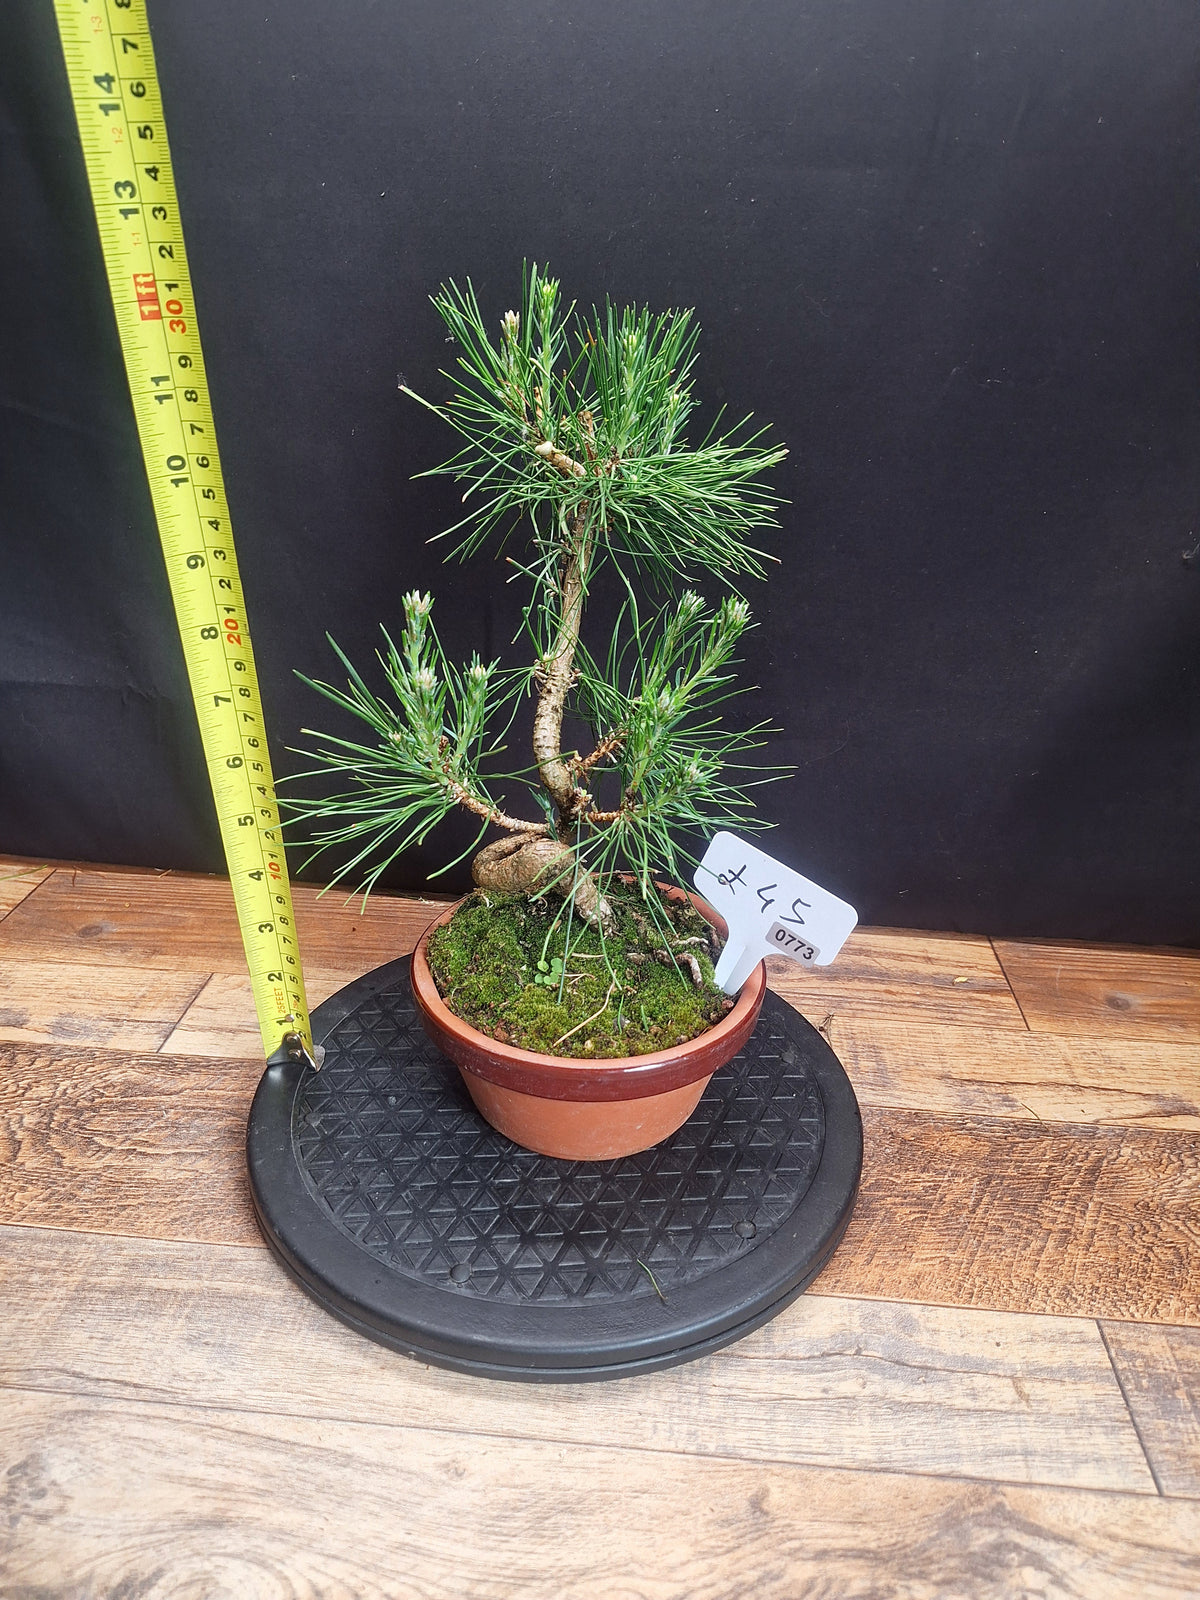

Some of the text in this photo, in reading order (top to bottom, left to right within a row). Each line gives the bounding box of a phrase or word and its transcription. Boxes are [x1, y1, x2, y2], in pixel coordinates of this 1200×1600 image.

[121, 38, 139, 54] 7
[93, 73, 120, 116] 14
[130, 81, 146, 98] 6
[137, 125, 154, 140] 5
[145, 165, 160, 181] 4
[114, 180, 140, 220] 13
[152, 206, 167, 220] 3
[159, 245, 174, 259] 2
[165, 283, 179, 292] 1
[166, 299, 187, 334] 30
[178, 355, 192, 368] 9
[150, 375, 173, 405] 11
[184, 390, 198, 403] 8
[190, 423, 204, 435] 7
[196, 456, 210, 468] 6
[166, 455, 189, 488] 10
[202, 488, 216, 501] 5
[208, 519, 221, 531] 4
[213, 549, 226, 561] 3
[186, 554, 206, 570] 9
[218, 579, 232, 590] 2
[200, 626, 219, 640] 8
[224, 618, 242, 646] 20
[234, 661, 246, 672] 9
[239, 688, 251, 698] 8
[214, 695, 232, 707] 7
[243, 713, 256, 723] 7
[248, 738, 260, 748] 6
[226, 756, 244, 769] 6
[253, 762, 264, 772] 5
[257, 786, 267, 796] 4
[261, 809, 271, 819] 3
[238, 815, 255, 827] 5
[264, 831, 276, 841] 2
[248, 870, 264, 881] 4
[268, 862, 282, 880] 10
[276, 896, 286, 905] 9
[279, 916, 289, 926] 8
[258, 923, 274, 933] 3
[283, 936, 292, 945] 7
[775, 929, 814, 960] 0773
[286, 956, 295, 965] 6
[267, 972, 283, 982] 2
[289, 975, 299, 984] 5
[292, 994, 301, 1002] 4
[276, 1018, 292, 1026] 1
[295, 1012, 304, 1021] 3
